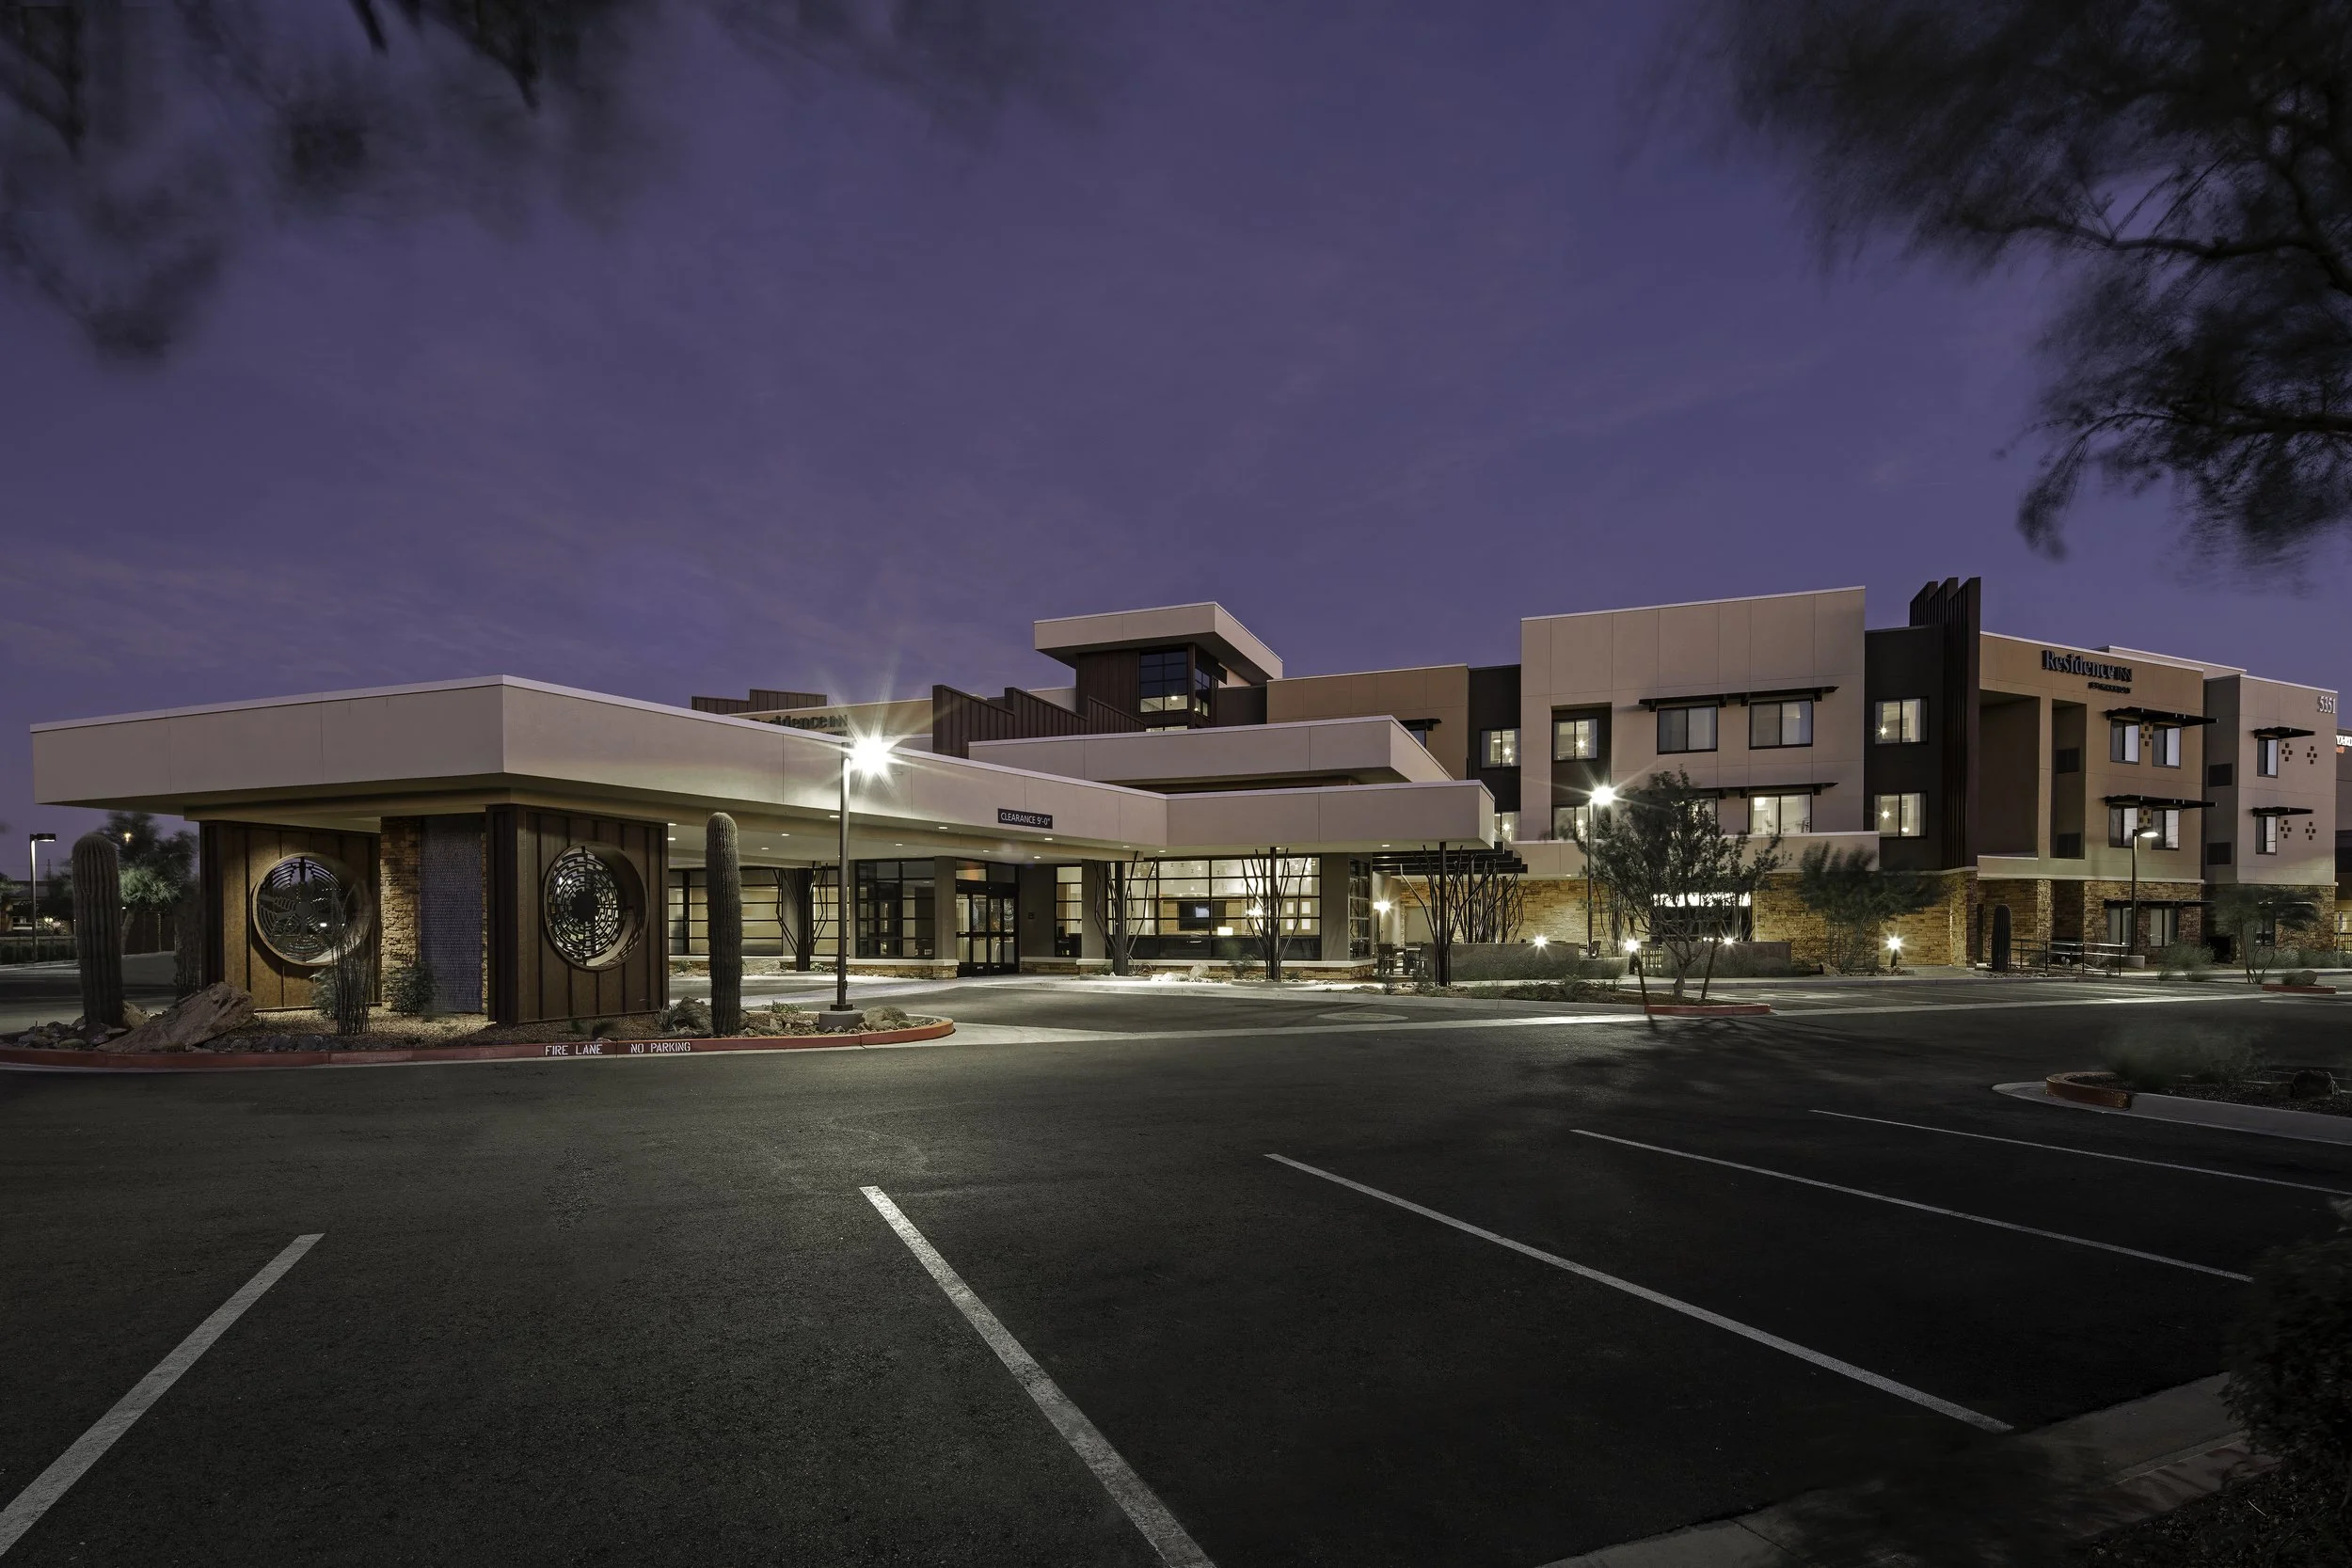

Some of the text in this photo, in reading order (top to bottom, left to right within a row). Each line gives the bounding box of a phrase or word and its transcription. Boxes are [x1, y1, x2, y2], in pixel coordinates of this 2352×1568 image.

[2042, 650, 2115, 679] Residence
[2319, 696, 2337, 714] 5351
[1000, 812, 1036, 824] CLEARANCE
[545, 1041, 691, 1055] FIRE LANE NO PARKING
